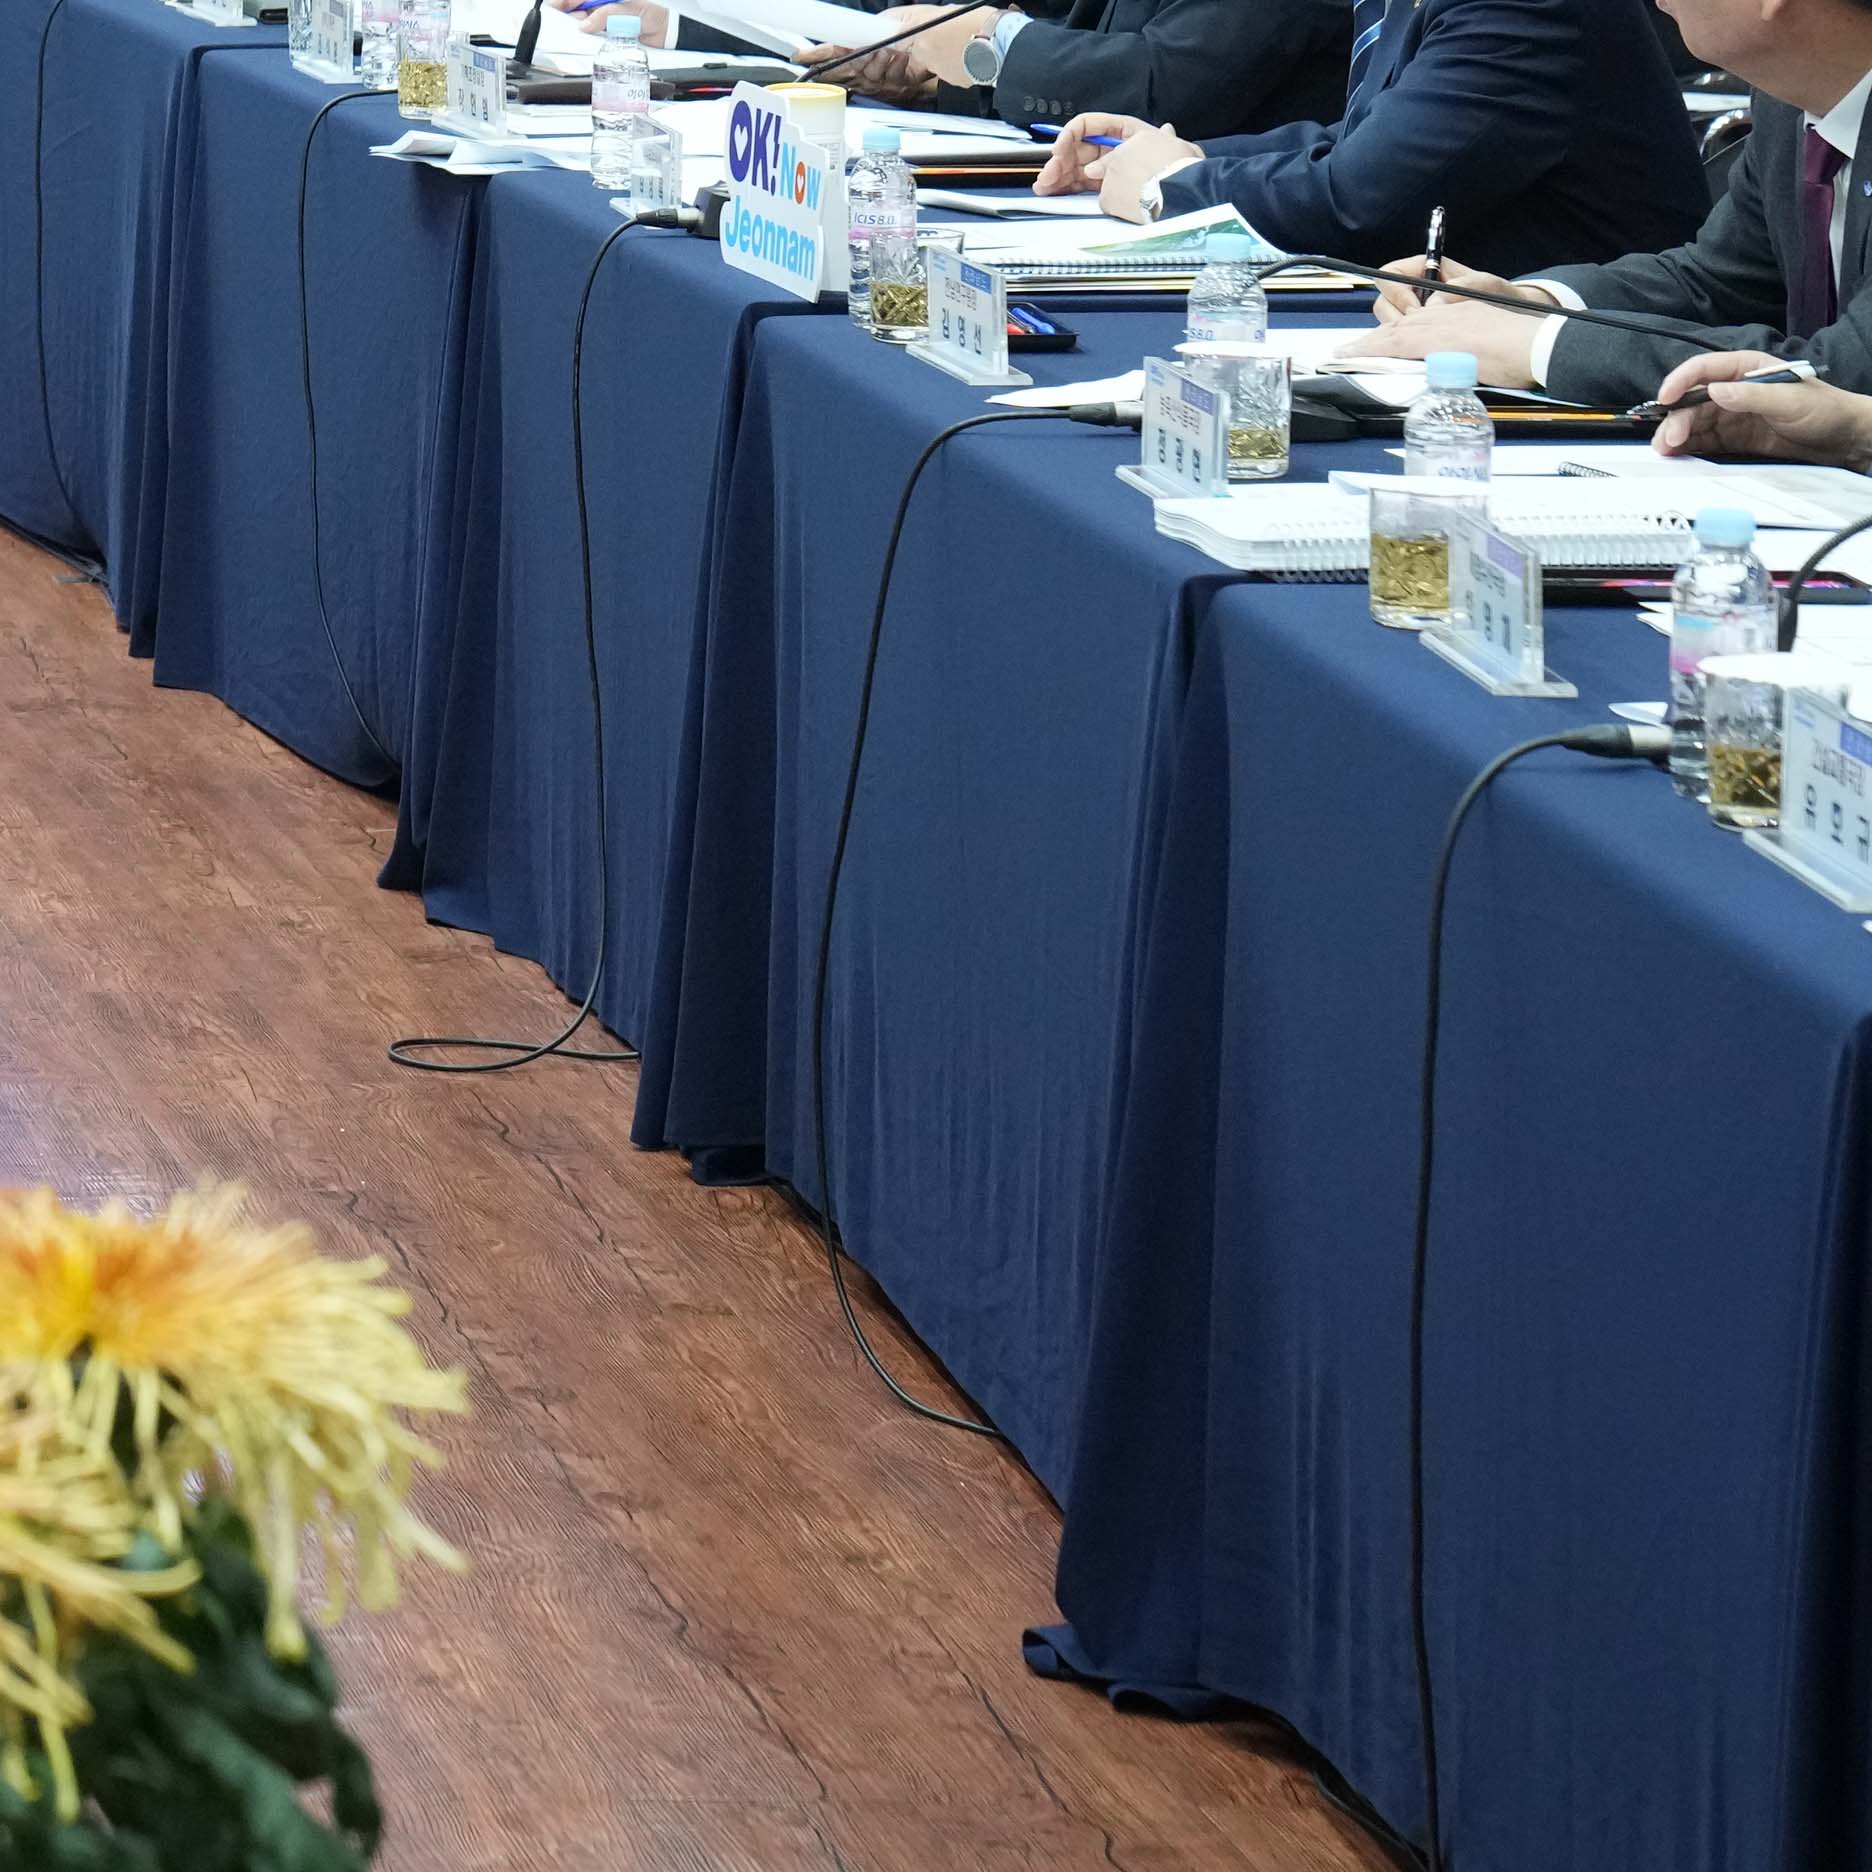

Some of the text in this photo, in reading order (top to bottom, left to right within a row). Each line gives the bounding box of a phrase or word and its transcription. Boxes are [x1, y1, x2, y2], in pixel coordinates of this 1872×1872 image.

[729, 100, 782, 196] OK!
[725, 195, 816, 280] Jeonnam
[854, 211, 876, 225] ICIS
